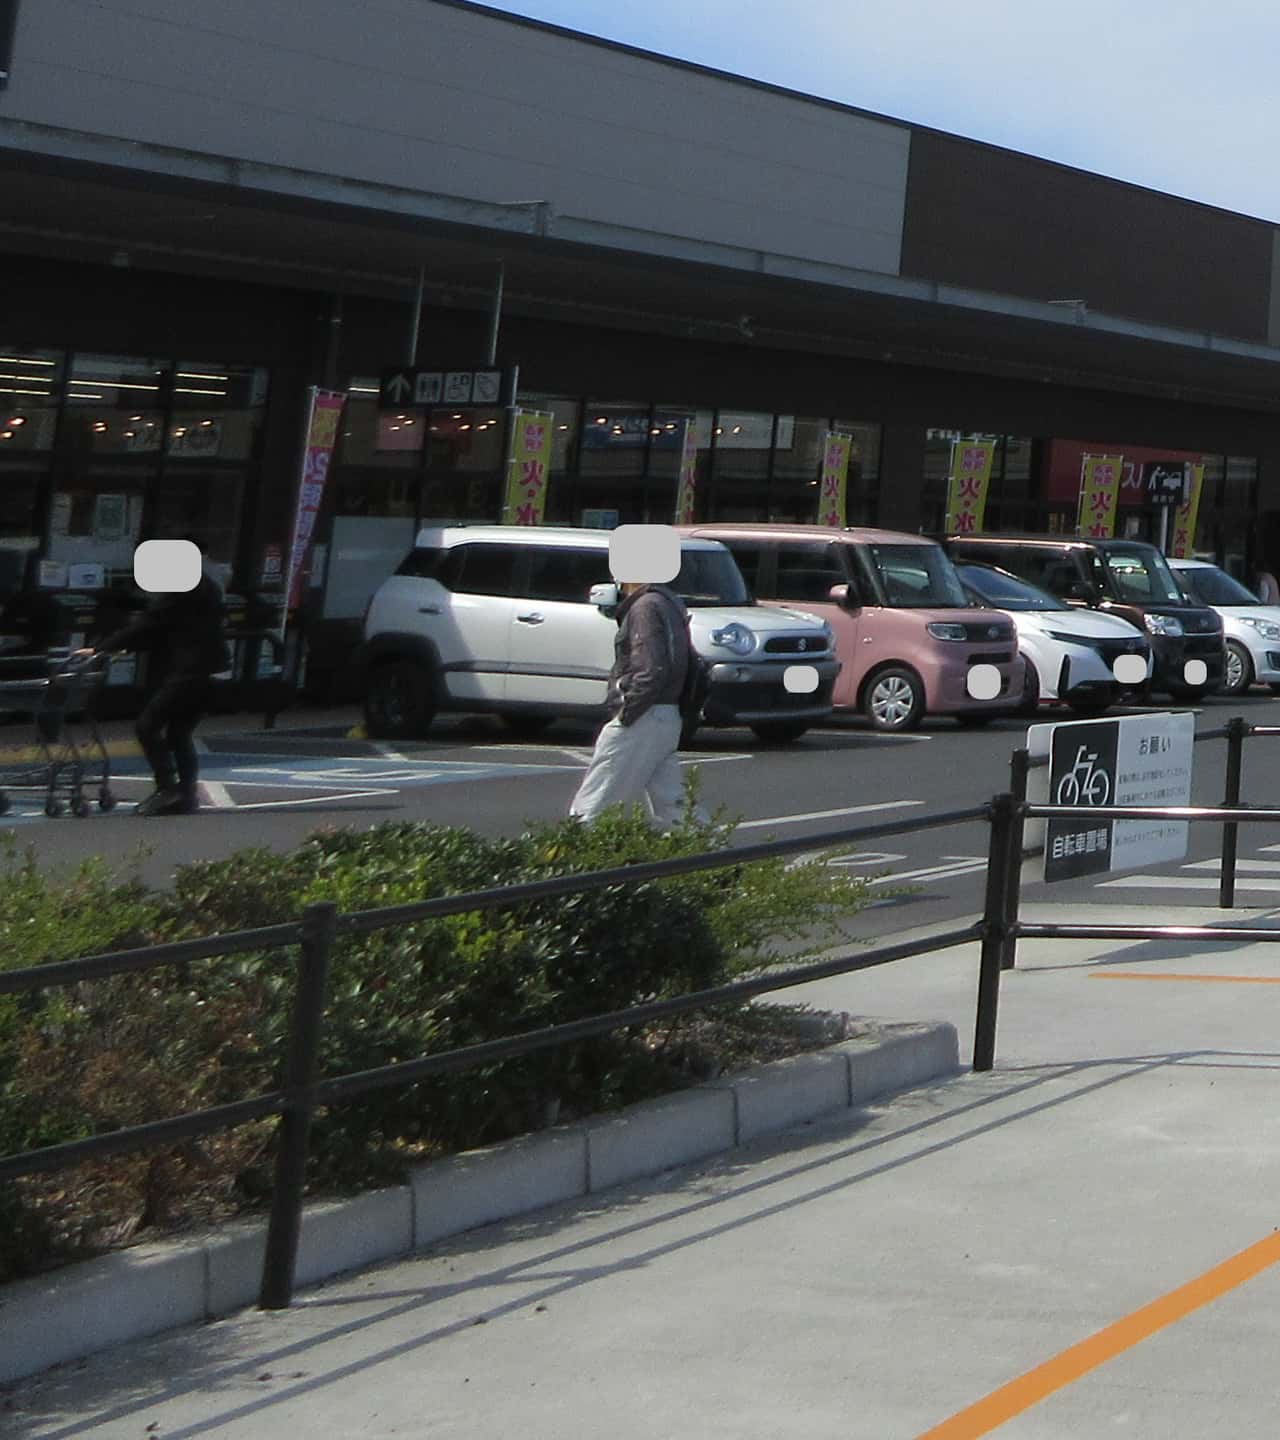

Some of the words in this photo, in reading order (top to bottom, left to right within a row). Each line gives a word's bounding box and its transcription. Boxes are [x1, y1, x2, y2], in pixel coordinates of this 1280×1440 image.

[1138, 736, 1171, 756] お願い
[1052, 828, 1108, 859] 自転車置場
